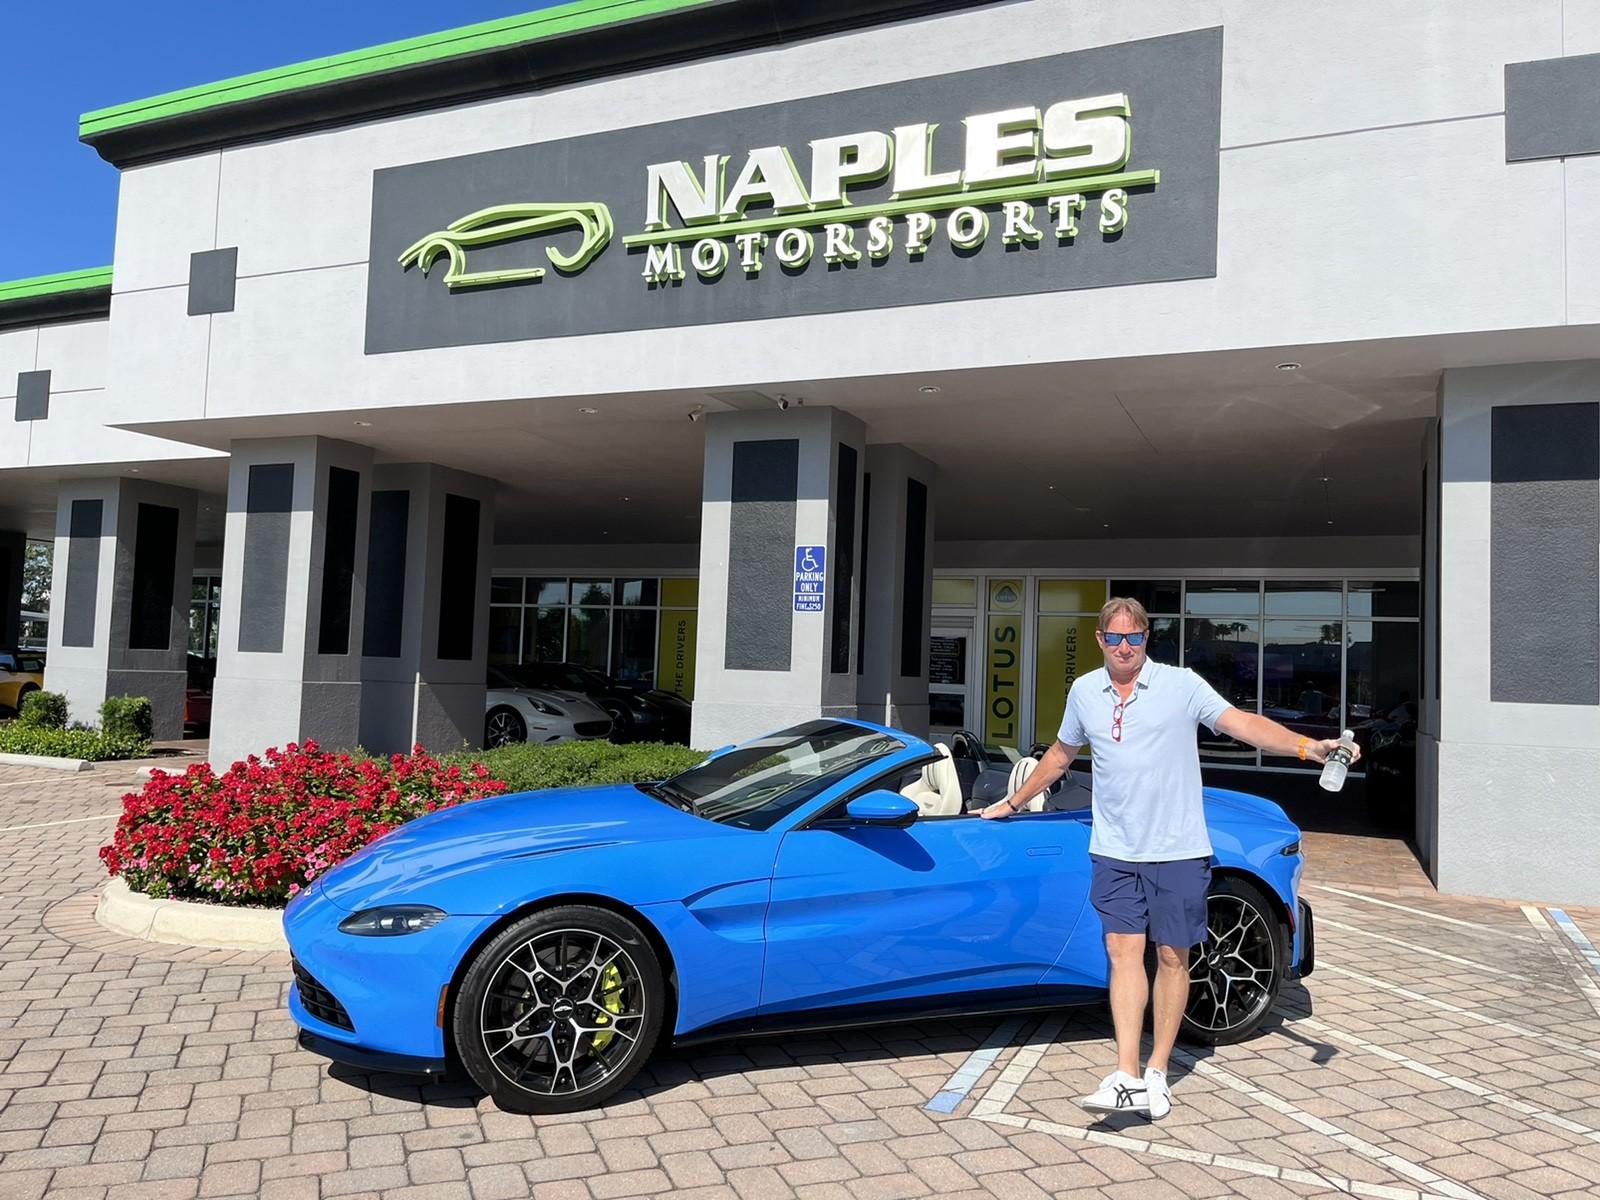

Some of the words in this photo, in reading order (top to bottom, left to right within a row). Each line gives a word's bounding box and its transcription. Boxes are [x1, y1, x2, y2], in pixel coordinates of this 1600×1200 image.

[644, 92, 1132, 230] NAPLES
[641, 188, 1128, 282] MOTORSPORTS
[796, 571, 824, 581] PARKING
[800, 582, 818, 592] ONLY
[677, 620, 686, 669] DRIVERS
[1065, 627, 1077, 684] DRIVERS
[992, 626, 1015, 739] LOTUS
